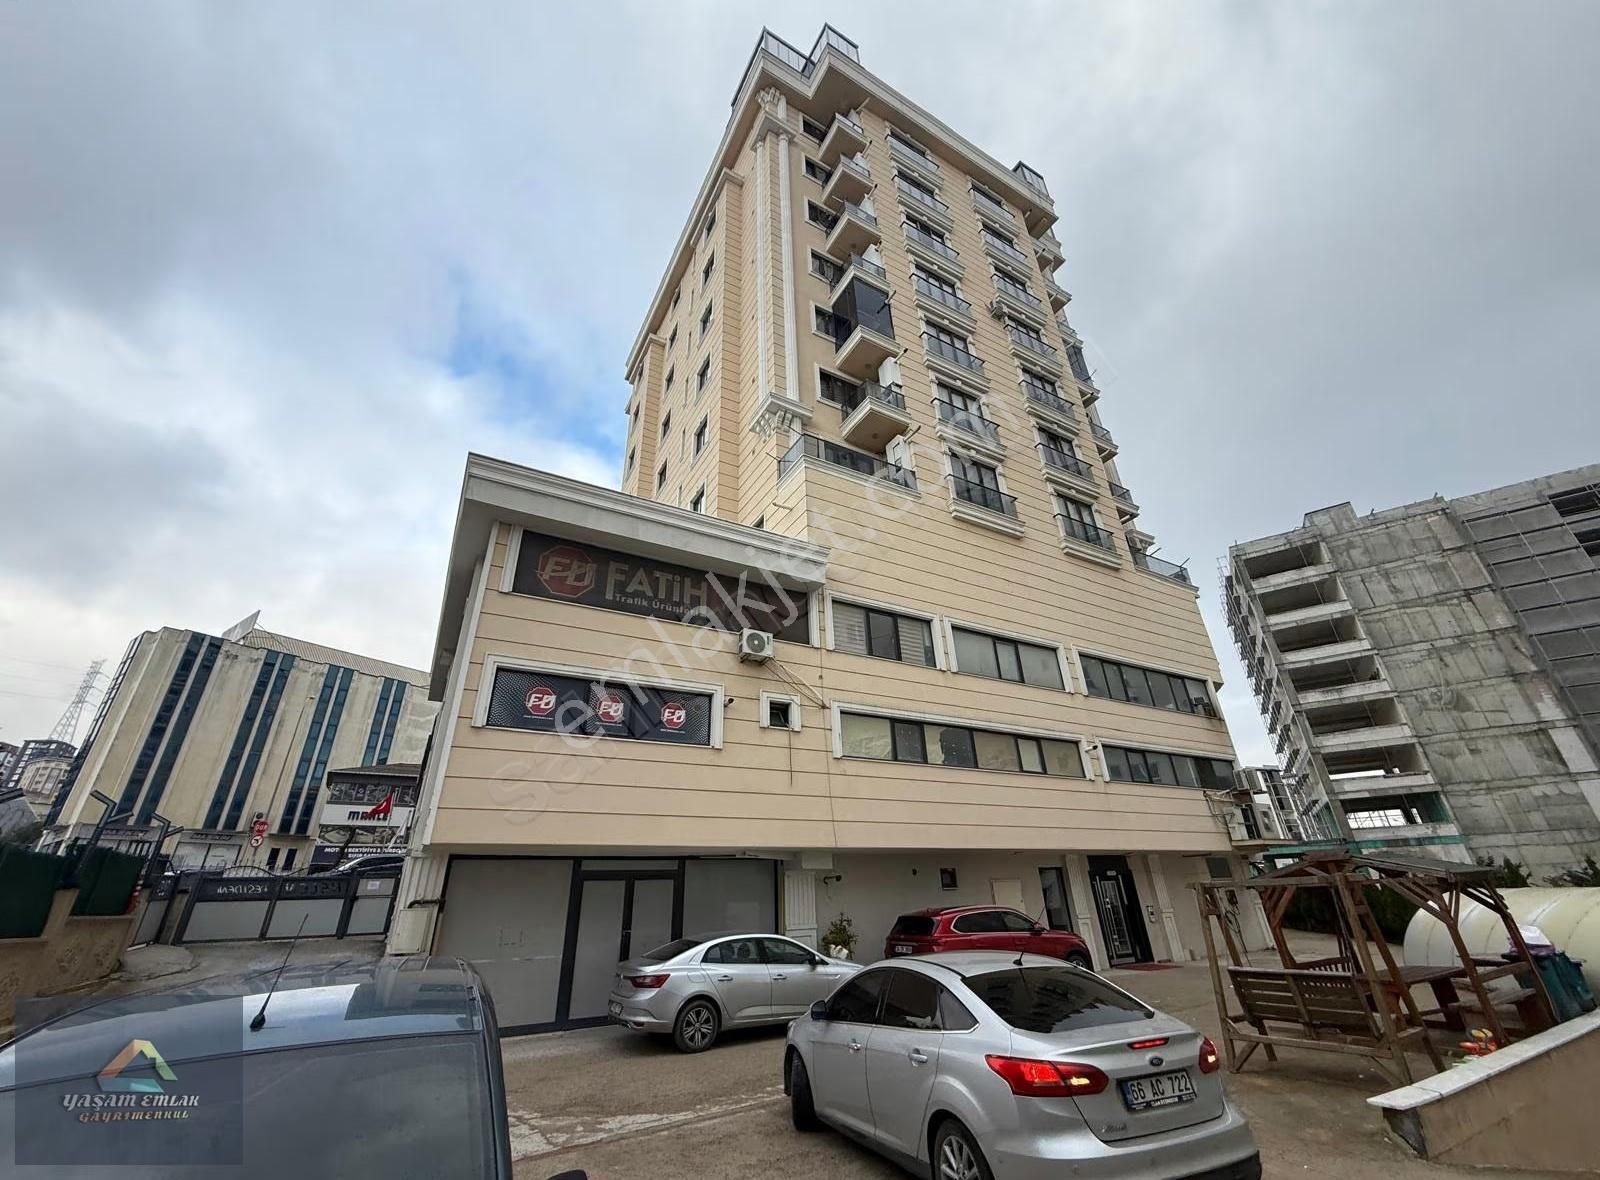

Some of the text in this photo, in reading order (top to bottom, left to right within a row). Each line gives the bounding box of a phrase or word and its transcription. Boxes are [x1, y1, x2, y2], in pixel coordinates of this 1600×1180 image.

[1129, 1074, 1191, 1101] 66 AC 722
